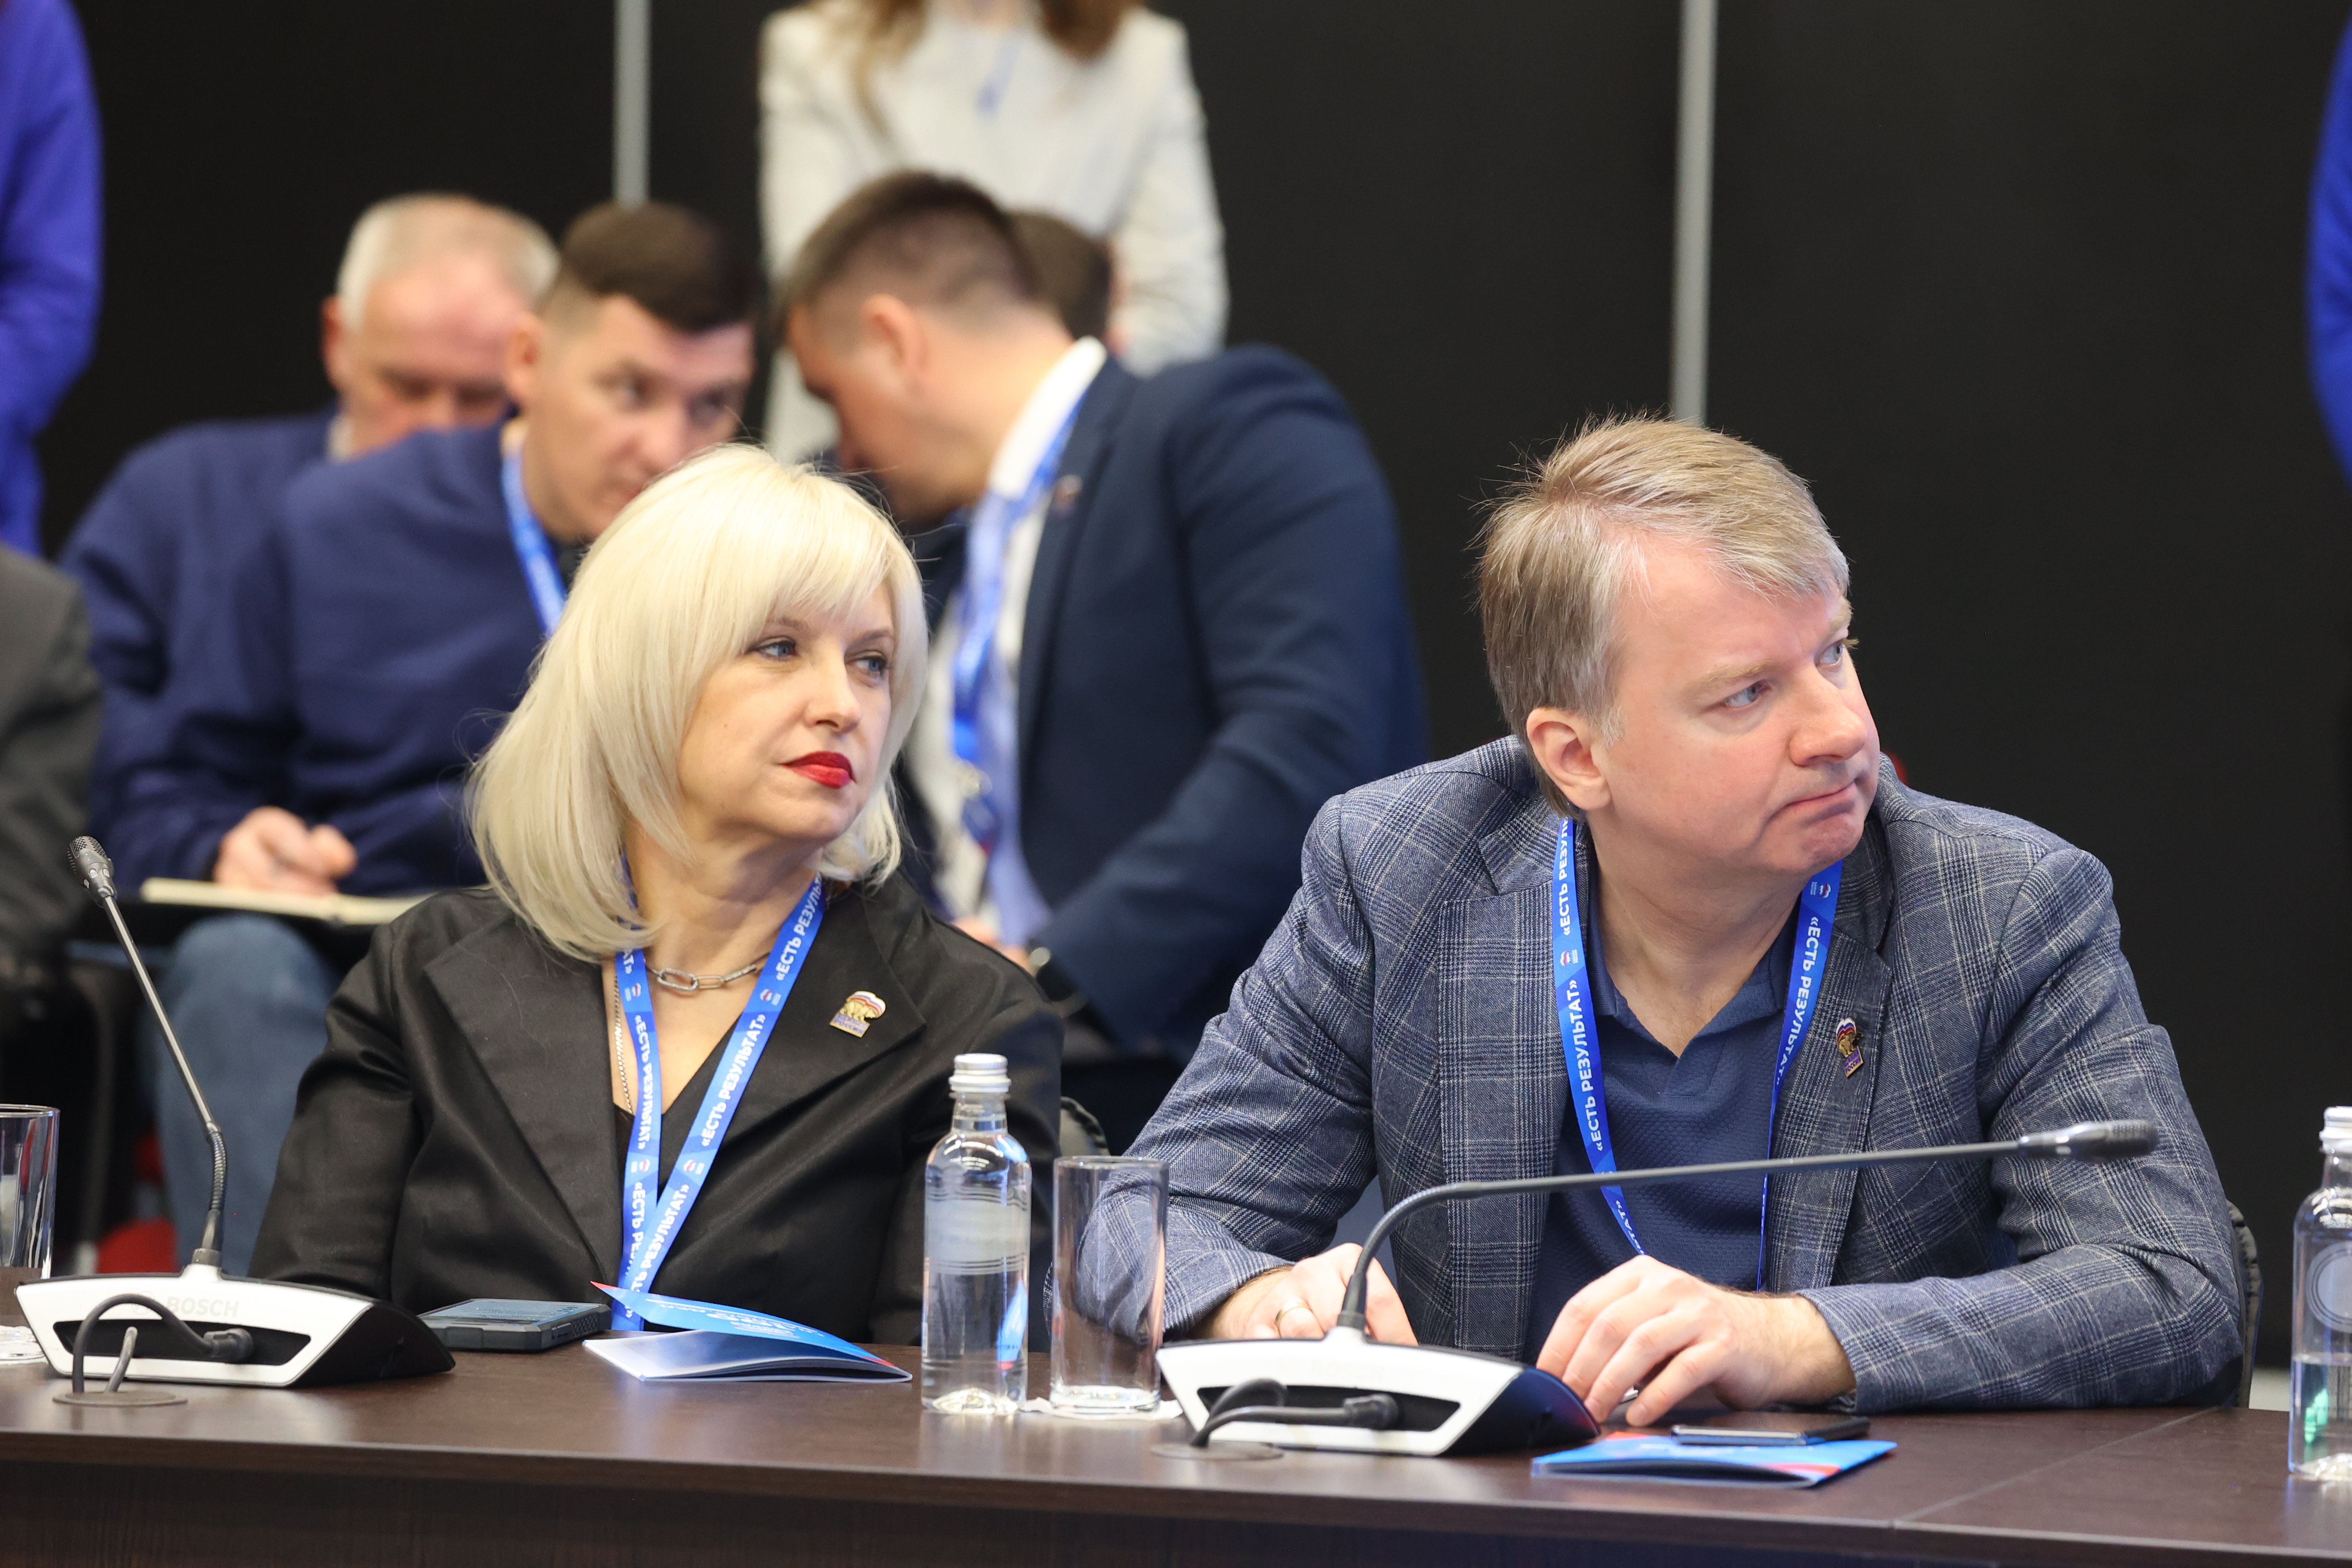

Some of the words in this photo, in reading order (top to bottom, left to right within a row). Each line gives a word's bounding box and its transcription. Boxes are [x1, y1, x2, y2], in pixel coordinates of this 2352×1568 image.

[1559, 883, 1571, 936] «ЕСТЬ
[775, 937, 802, 981] «ЕСТЬ
[1803, 916, 1821, 971] «ЕСТЬ
[634, 1015, 650, 1063] «ЕСТЬ
[1567, 980, 1594, 1092] РЕЗУЛЬТАТ»
[638, 1063, 653, 1149] РЕЗУЛЬТАТ»
[701, 1101, 727, 1146] «ЕСТЬ
[718, 1014, 766, 1100] РЕЗУЛЬТАТ»
[1585, 1096, 1604, 1151] «ЕСТЬ
[631, 1182, 646, 1229] «ЕСТЬ
[640, 1184, 689, 1269] РЕЗУЛЬТАТ»
[167, 1296, 240, 1318] BOSCH
